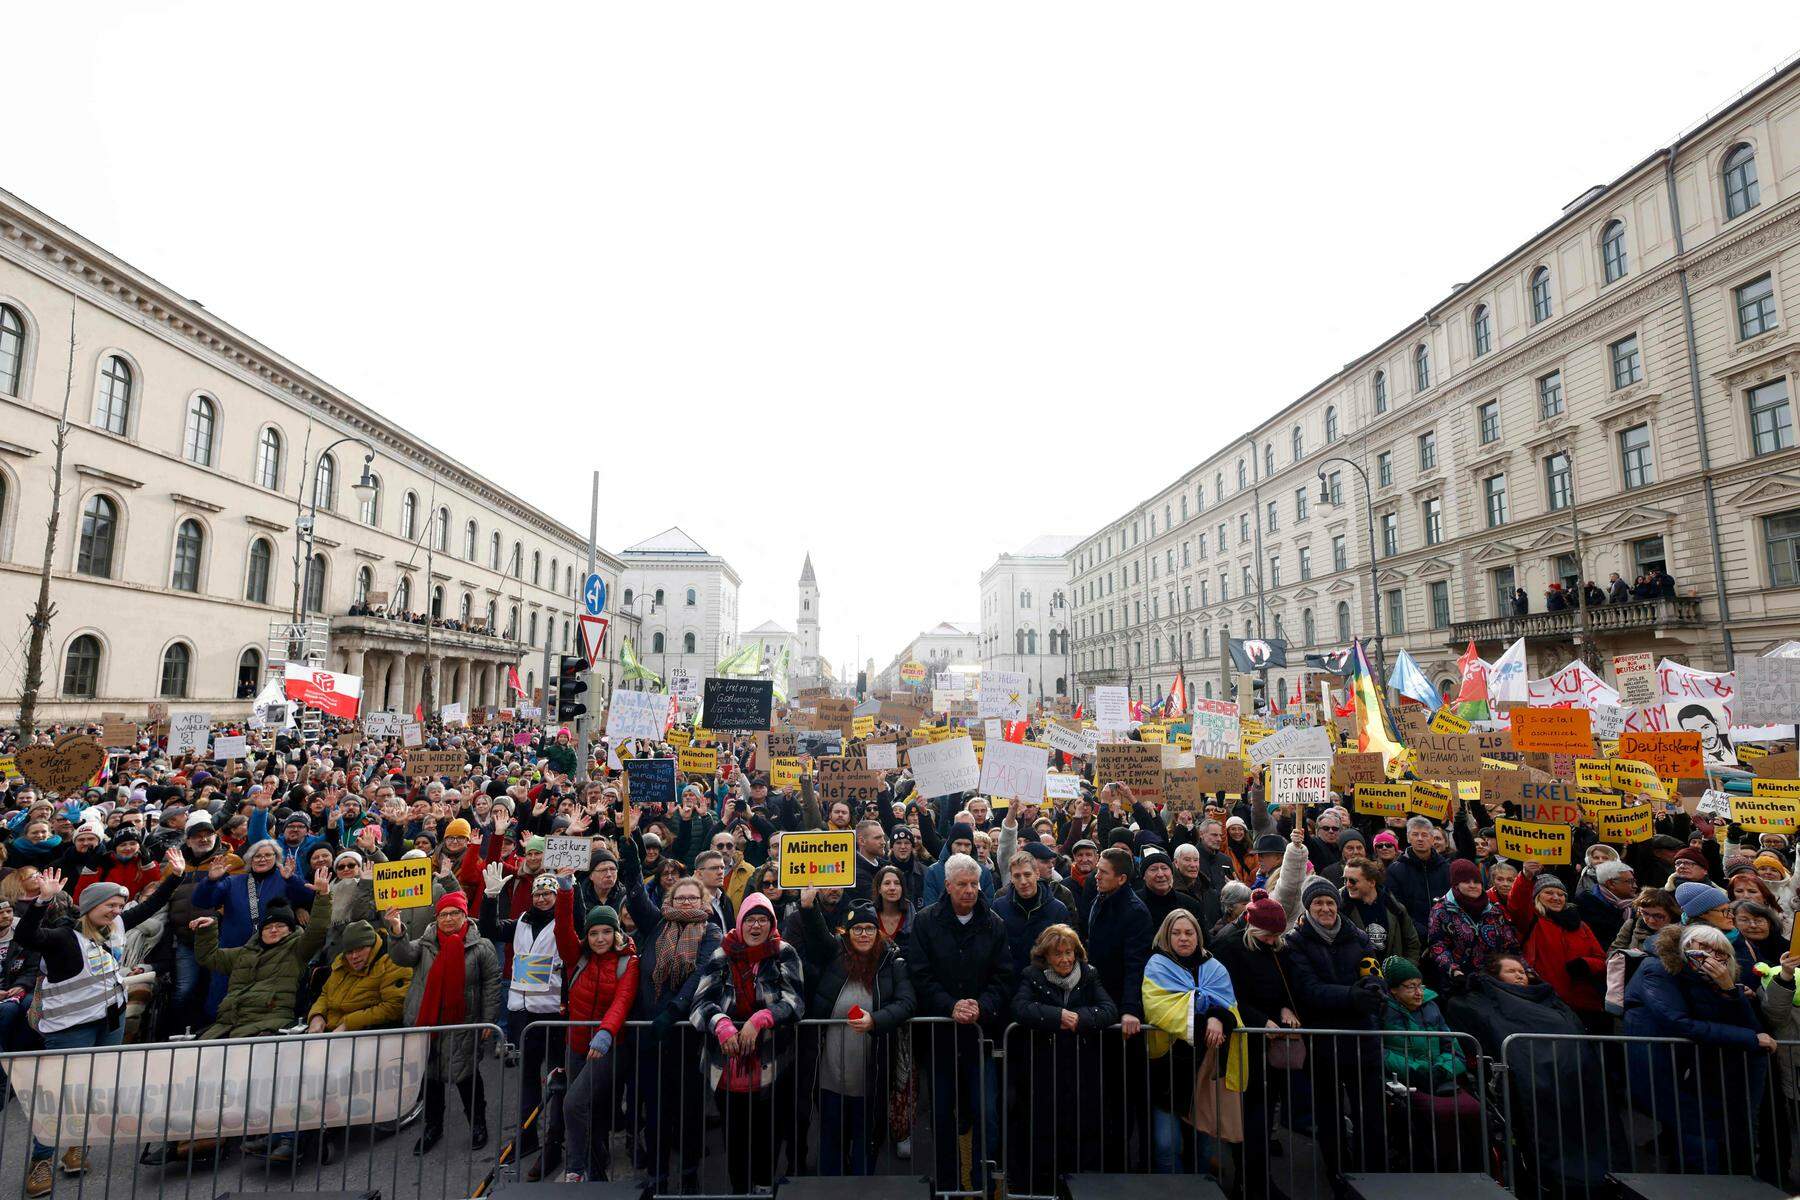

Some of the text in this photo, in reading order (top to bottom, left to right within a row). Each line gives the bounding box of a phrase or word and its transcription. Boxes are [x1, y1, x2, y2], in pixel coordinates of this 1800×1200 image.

[1198, 698, 1238, 717] JEDER
[368, 714, 409, 724] Kein Bier
[385, 725, 401, 733] Nazi
[180, 731, 195, 739] IST
[768, 734, 794, 745] Es ist
[1419, 737, 1470, 752] ALICE,
[1625, 737, 1700, 754] Deutschland
[682, 750, 714, 758] München
[768, 746, 775, 757] 5
[1739, 747, 1766, 757] München
[410, 753, 463, 763] NIE WIEDER
[1101, 756, 1123, 764] NICHT
[1123, 755, 1138, 763] MAL
[1420, 753, 1458, 763] NIEMAND
[1654, 754, 1666, 763] ist
[413, 765, 462, 774] IST JETZT
[682, 761, 712, 771] ist bunt!
[1276, 763, 1326, 776] FASCHISMUS
[777, 770, 786, 780] ist
[821, 774, 832, 783] und
[847, 774, 872, 783] anderen
[1114, 770, 1126, 778] IST
[1128, 769, 1159, 777] EINFACH
[1279, 777, 1326, 789] IST KEINE
[1757, 782, 1800, 791] Münche
[821, 782, 880, 799] Hetzen
[1359, 788, 1407, 798] München
[1414, 785, 1448, 800] München
[1459, 787, 1479, 795] unt!
[1523, 783, 1575, 802] EKEL
[1361, 800, 1405, 811] ist bunt!
[1411, 797, 1444, 813] ist bunt!
[1735, 802, 1796, 812] München
[1523, 804, 1578, 822] HAFD
[1604, 811, 1649, 824] München
[1740, 815, 1795, 826] ist bunt!
[1501, 825, 1565, 840] München
[1607, 823, 1648, 837] ist bunt!
[547, 839, 587, 852] Es ist kurz
[787, 840, 848, 854] München
[1504, 841, 1562, 856] ist bunt!
[790, 860, 845, 874] ist bunt!
[376, 867, 427, 881] München
[378, 884, 424, 899] ist bunt!
